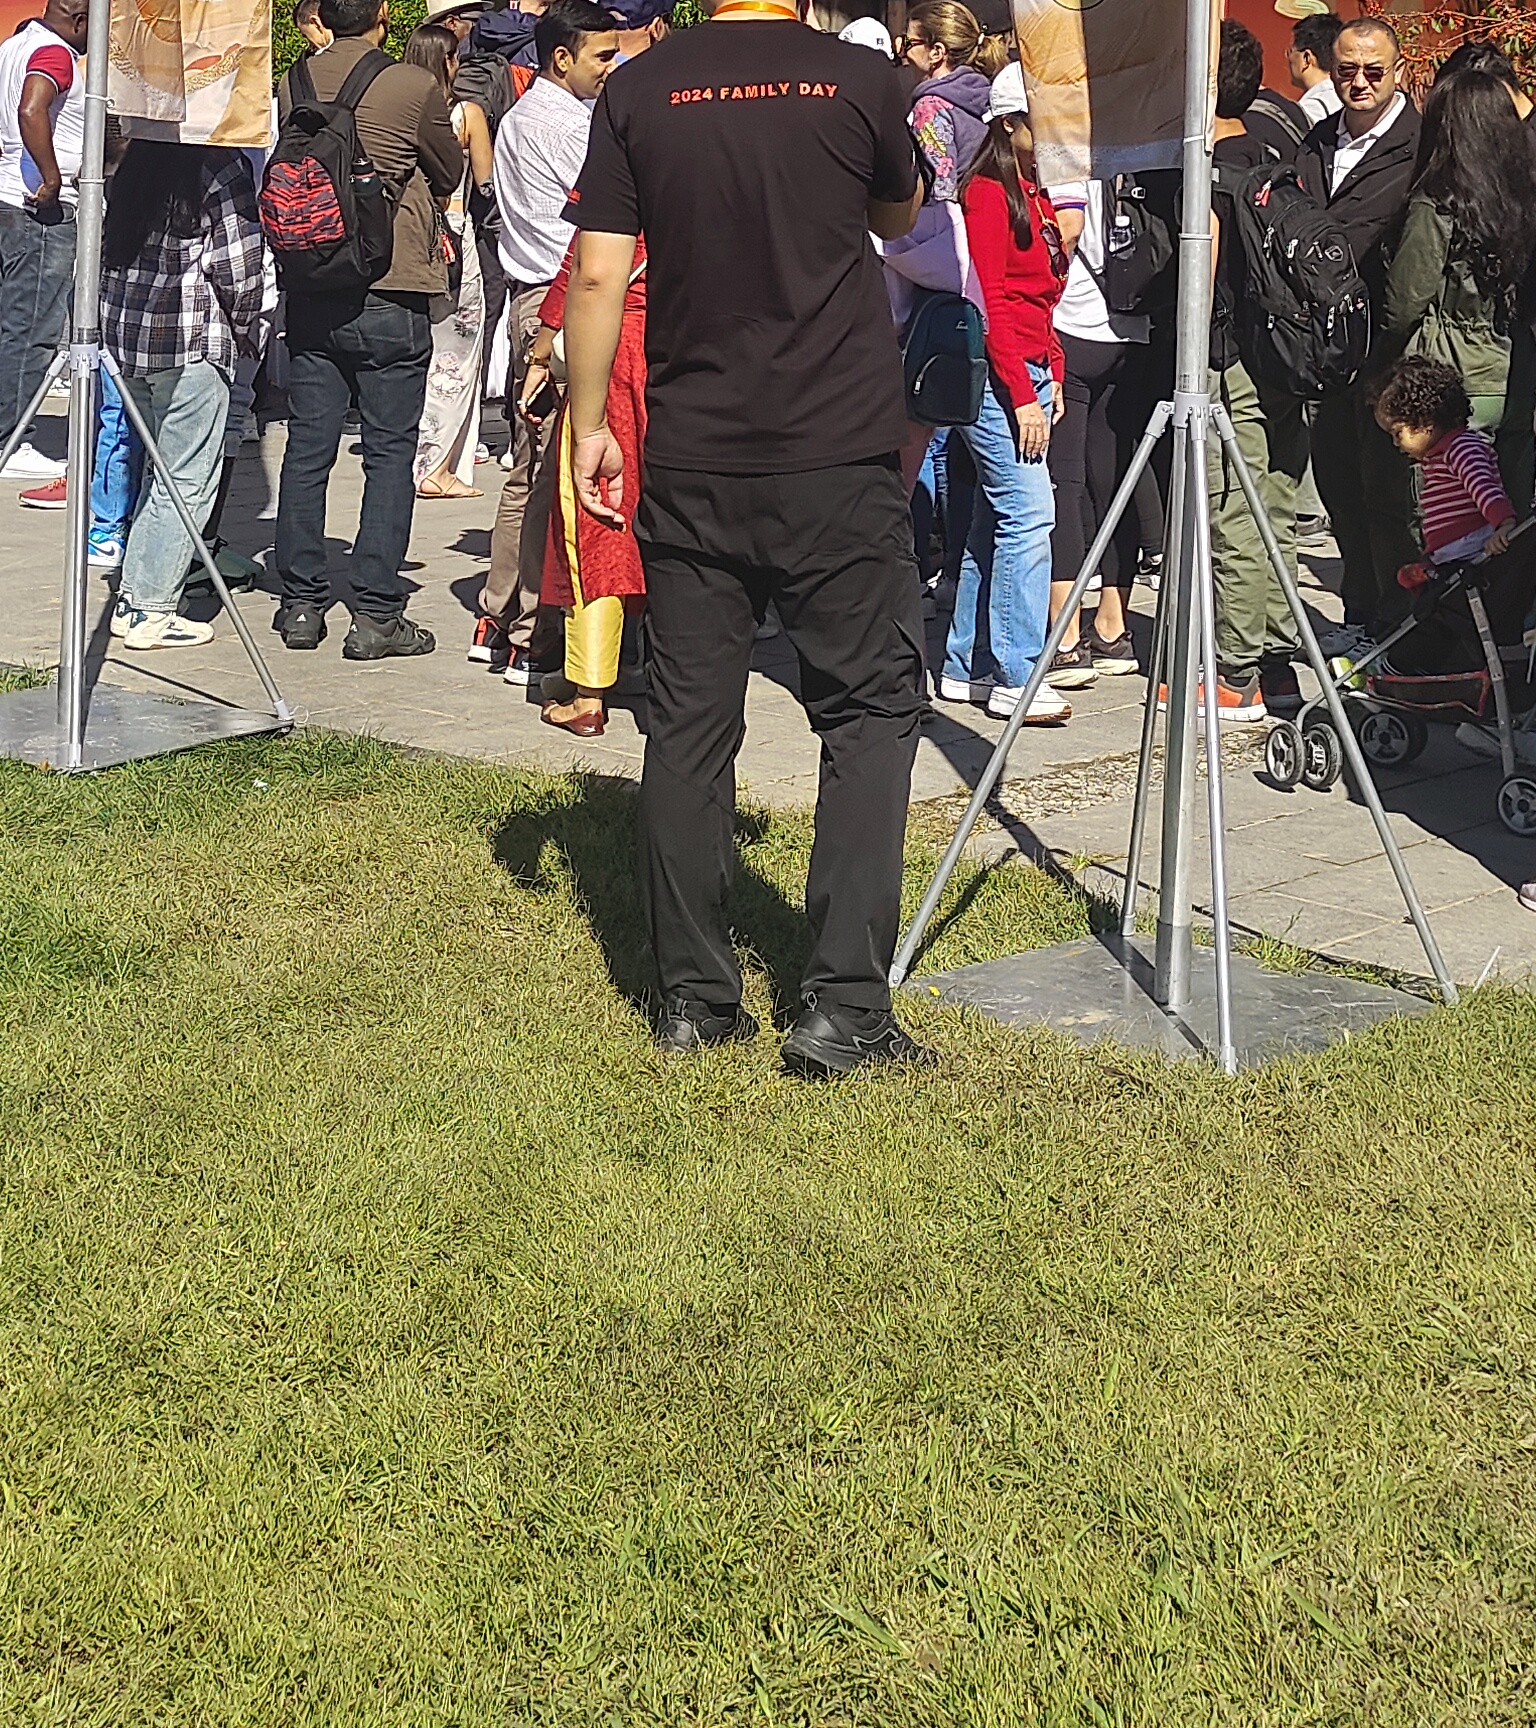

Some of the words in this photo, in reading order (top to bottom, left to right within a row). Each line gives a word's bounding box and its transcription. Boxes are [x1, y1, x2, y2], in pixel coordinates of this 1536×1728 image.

[669, 87, 714, 106] 2024
[719, 82, 790, 101] FAMILY
[798, 82, 838, 98] DAY
